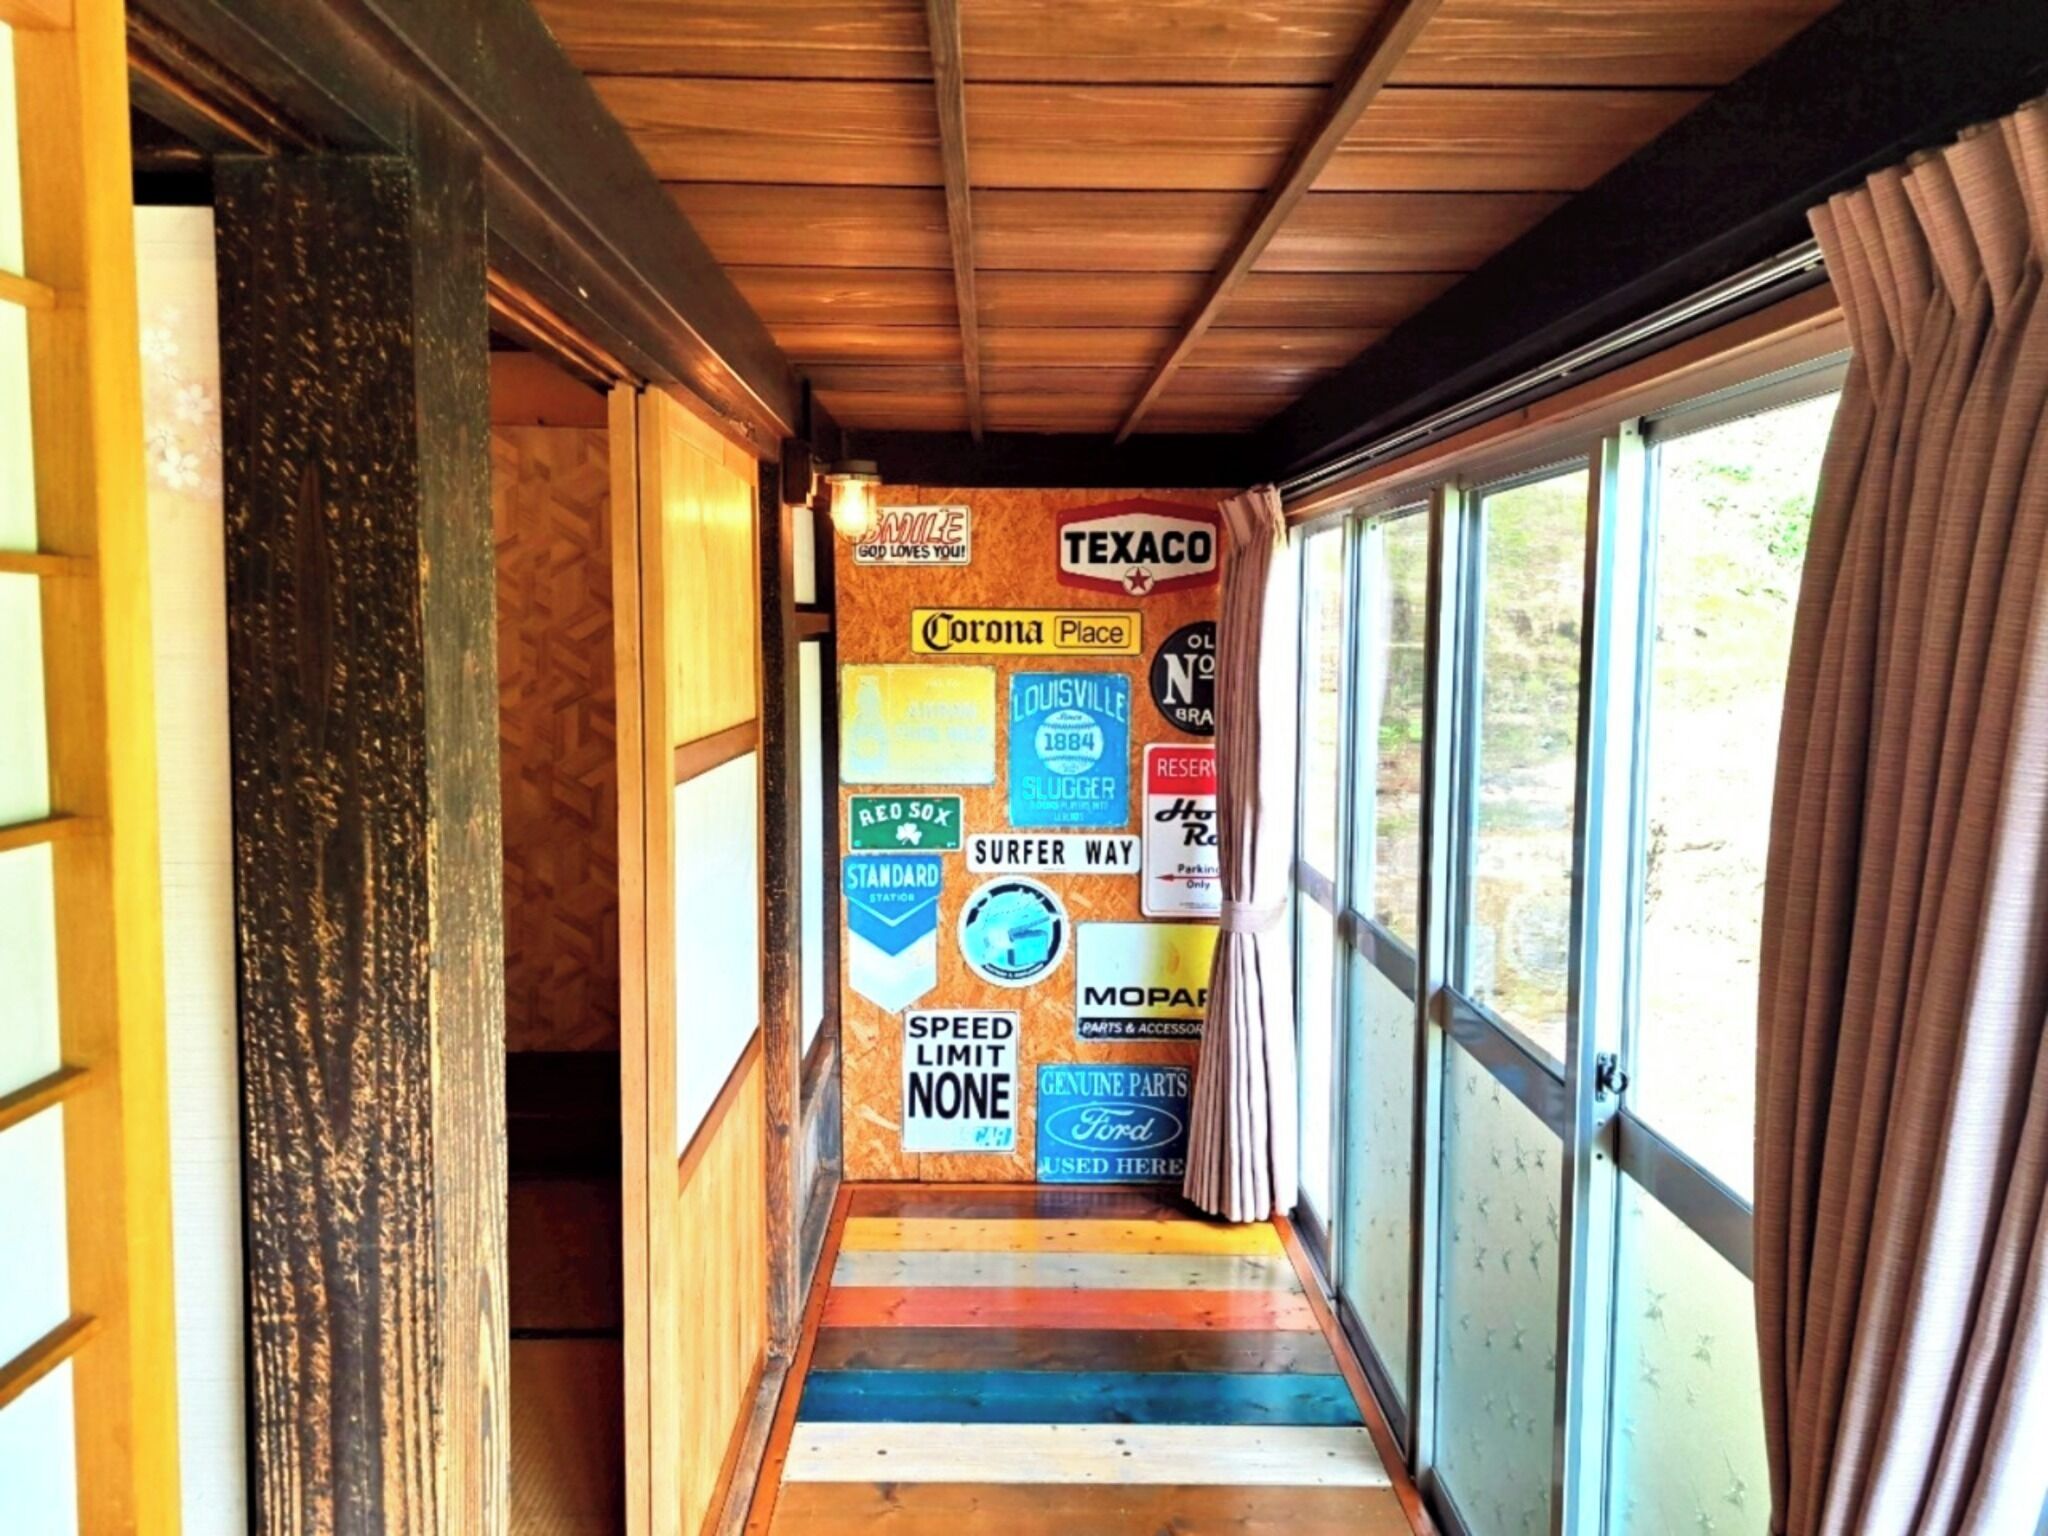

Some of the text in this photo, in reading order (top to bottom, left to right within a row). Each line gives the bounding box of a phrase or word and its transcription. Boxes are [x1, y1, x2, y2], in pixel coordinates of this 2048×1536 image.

[859, 545, 965, 558] GOD LOVES YOU!
[1064, 531, 1212, 564] TEXACO
[922, 612, 1124, 651] Corona Place
[1188, 634, 1214, 649] OL
[1013, 678, 1126, 723] LOUISVILLE
[1175, 708, 1214, 726] BRA
[1044, 733, 1095, 751] 1884
[1157, 758, 1216, 777] RESERV
[1022, 776, 1115, 800] SLUGGER
[859, 802, 953, 828] RED SOX
[1155, 798, 1216, 822] Ho
[1182, 822, 1218, 846] Ro
[975, 840, 1133, 865] SURFER WAY
[847, 863, 939, 889] STANDARD
[1178, 863, 1219, 874] Parkin
[869, 892, 914, 902] STATION
[1187, 880, 1210, 890] Only
[909, 1016, 1013, 1040] SPEED
[1082, 1021, 1204, 1035] PARTS & ACCESSOR
[917, 1044, 1006, 1067] LIMIT
[908, 1071, 1010, 1119] NONE
[1041, 1071, 1188, 1097] GENUINE PARTS
[1071, 1107, 1156, 1141] Ford
[1043, 1156, 1184, 1175] USED HERE
